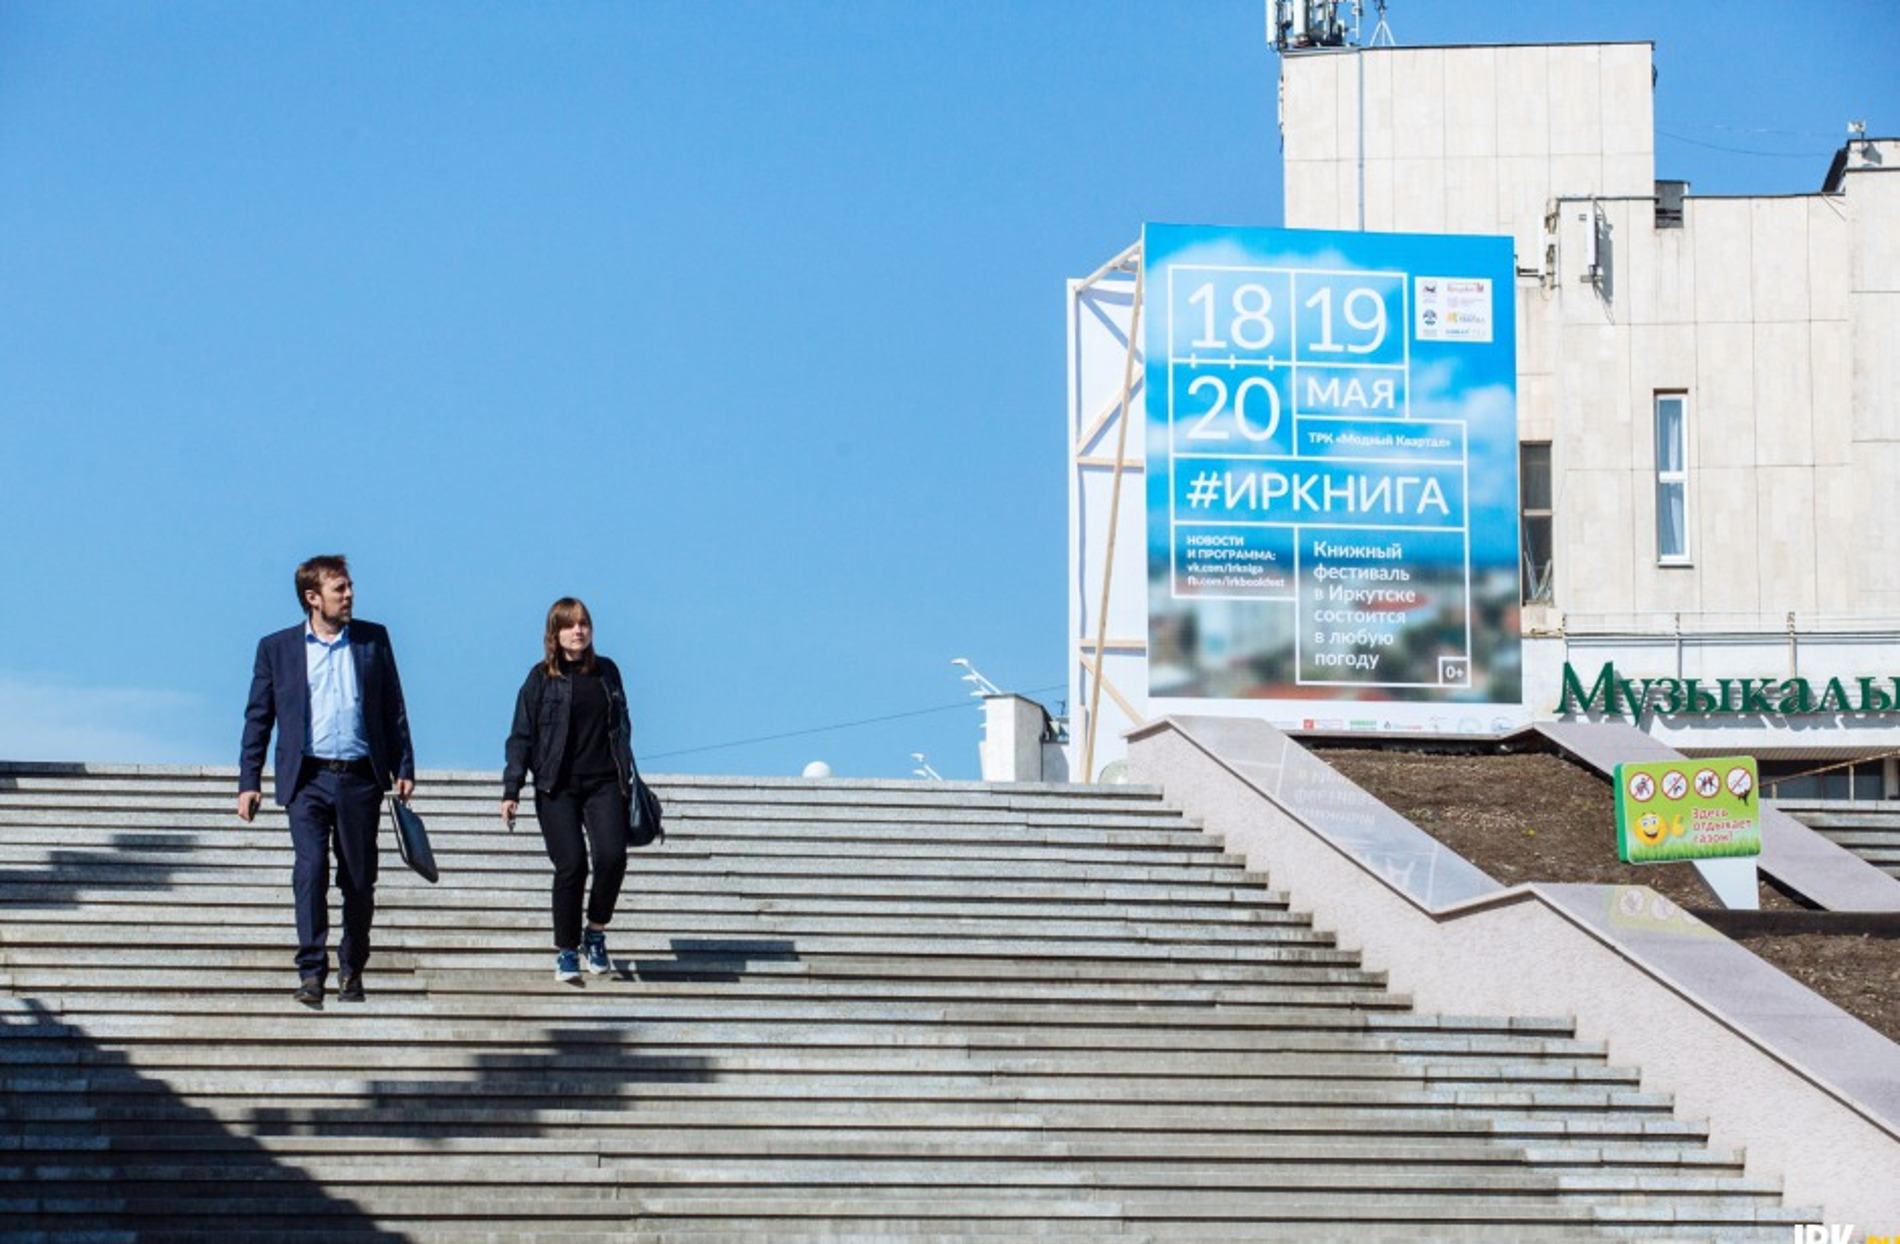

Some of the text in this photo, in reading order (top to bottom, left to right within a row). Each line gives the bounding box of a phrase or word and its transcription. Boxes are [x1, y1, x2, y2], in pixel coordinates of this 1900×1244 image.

[1187, 281, 1387, 354] 18 19
[1186, 375, 1395, 441] 20 МАЯ
[1308, 432, 1451, 448] ТРК «Модный Квартал»
[1186, 471, 1449, 514] #ИРКНИГА
[1186, 535, 1244, 547] НОВОСТИ
[1187, 549, 1276, 561] И ПРОГРАММА:
[1313, 541, 1402, 560] Книжный
[1313, 563, 1410, 582] фестиваль
[1314, 584, 1416, 604] в Иркутске
[1314, 609, 1406, 624] состоится
[1315, 629, 1394, 648] в любую
[1315, 653, 1379, 669] погоду
[1445, 666, 1464, 679] 0+
[1692, 808, 1729, 819] Здесь
